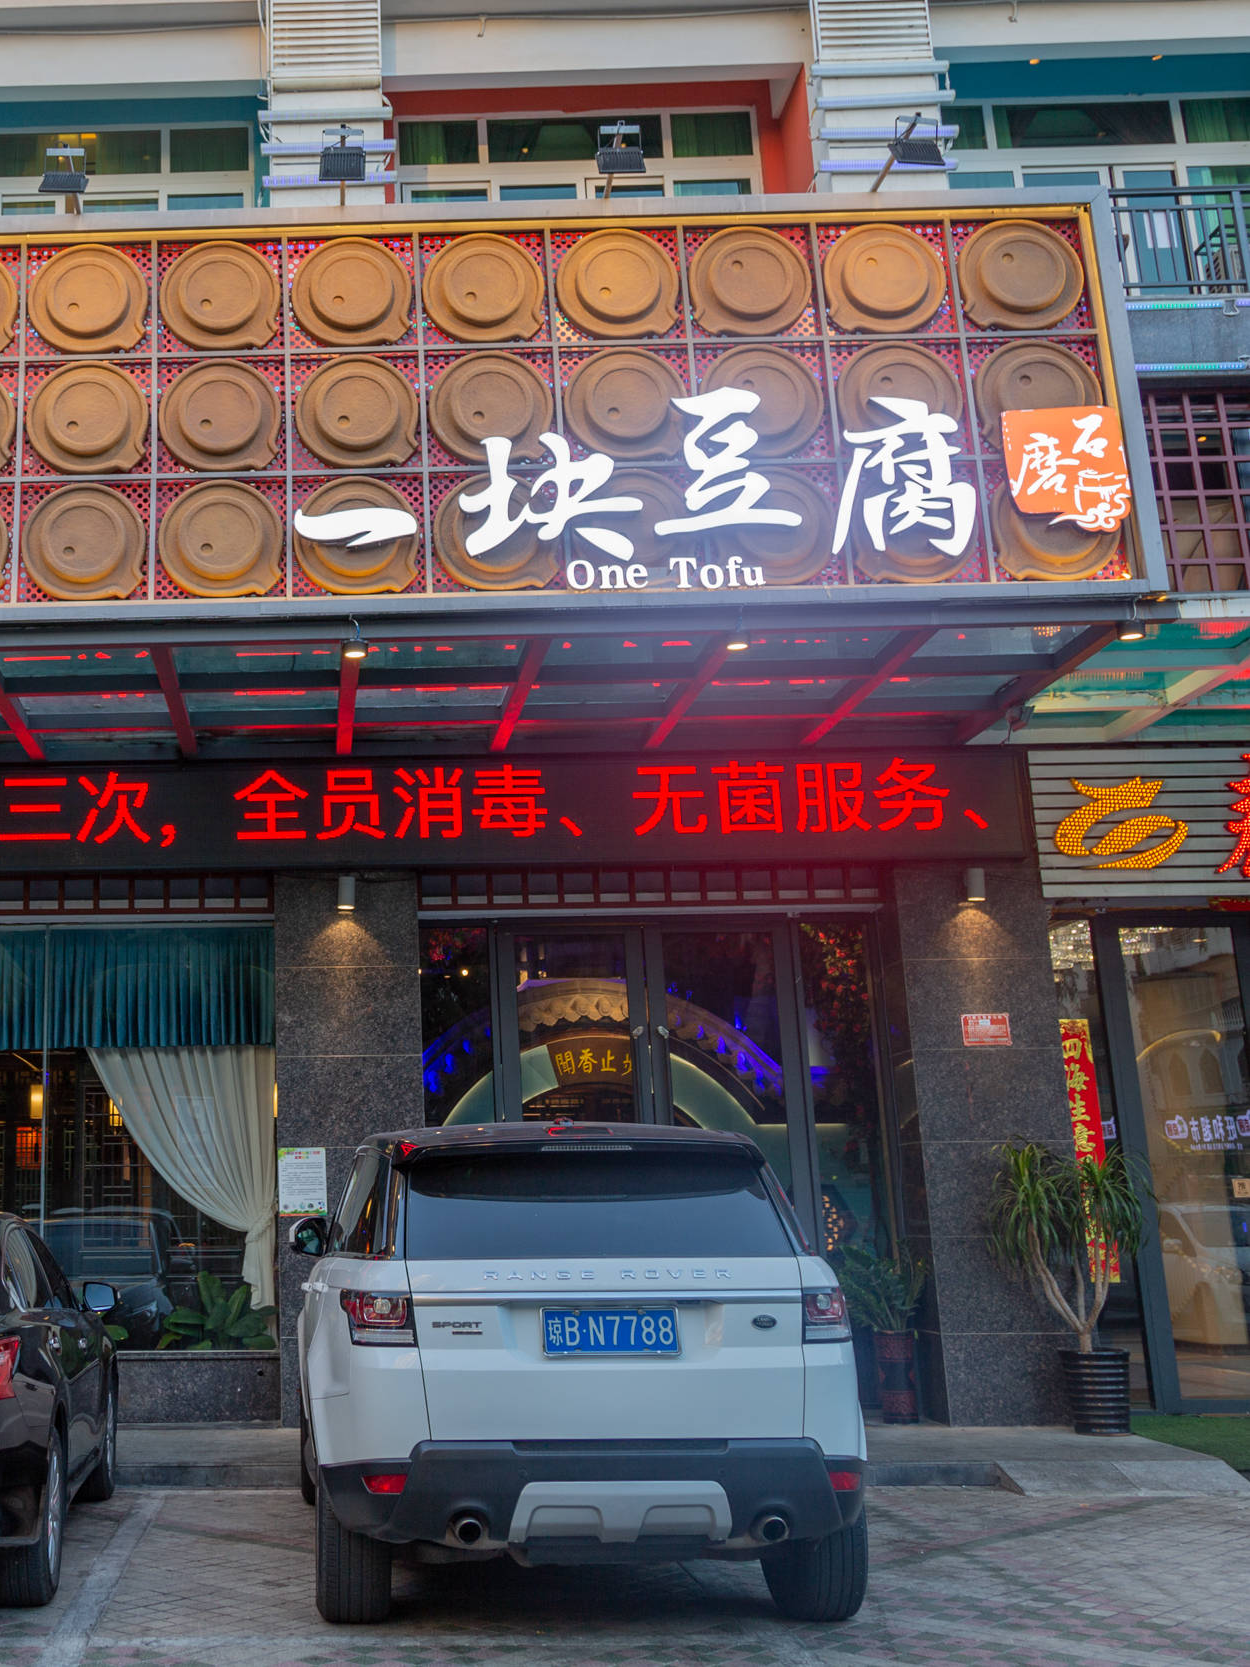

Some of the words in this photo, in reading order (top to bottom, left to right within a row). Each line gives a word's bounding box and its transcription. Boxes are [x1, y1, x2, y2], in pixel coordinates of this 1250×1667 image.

[294, 387, 978, 562] 一块豆腐
[566, 558, 648, 591] One
[668, 556, 766, 591] Tofu
[483, 1270, 596, 1281] RANGE
[621, 1269, 733, 1280] ROVER
[432, 1321, 482, 1329] SPORT
